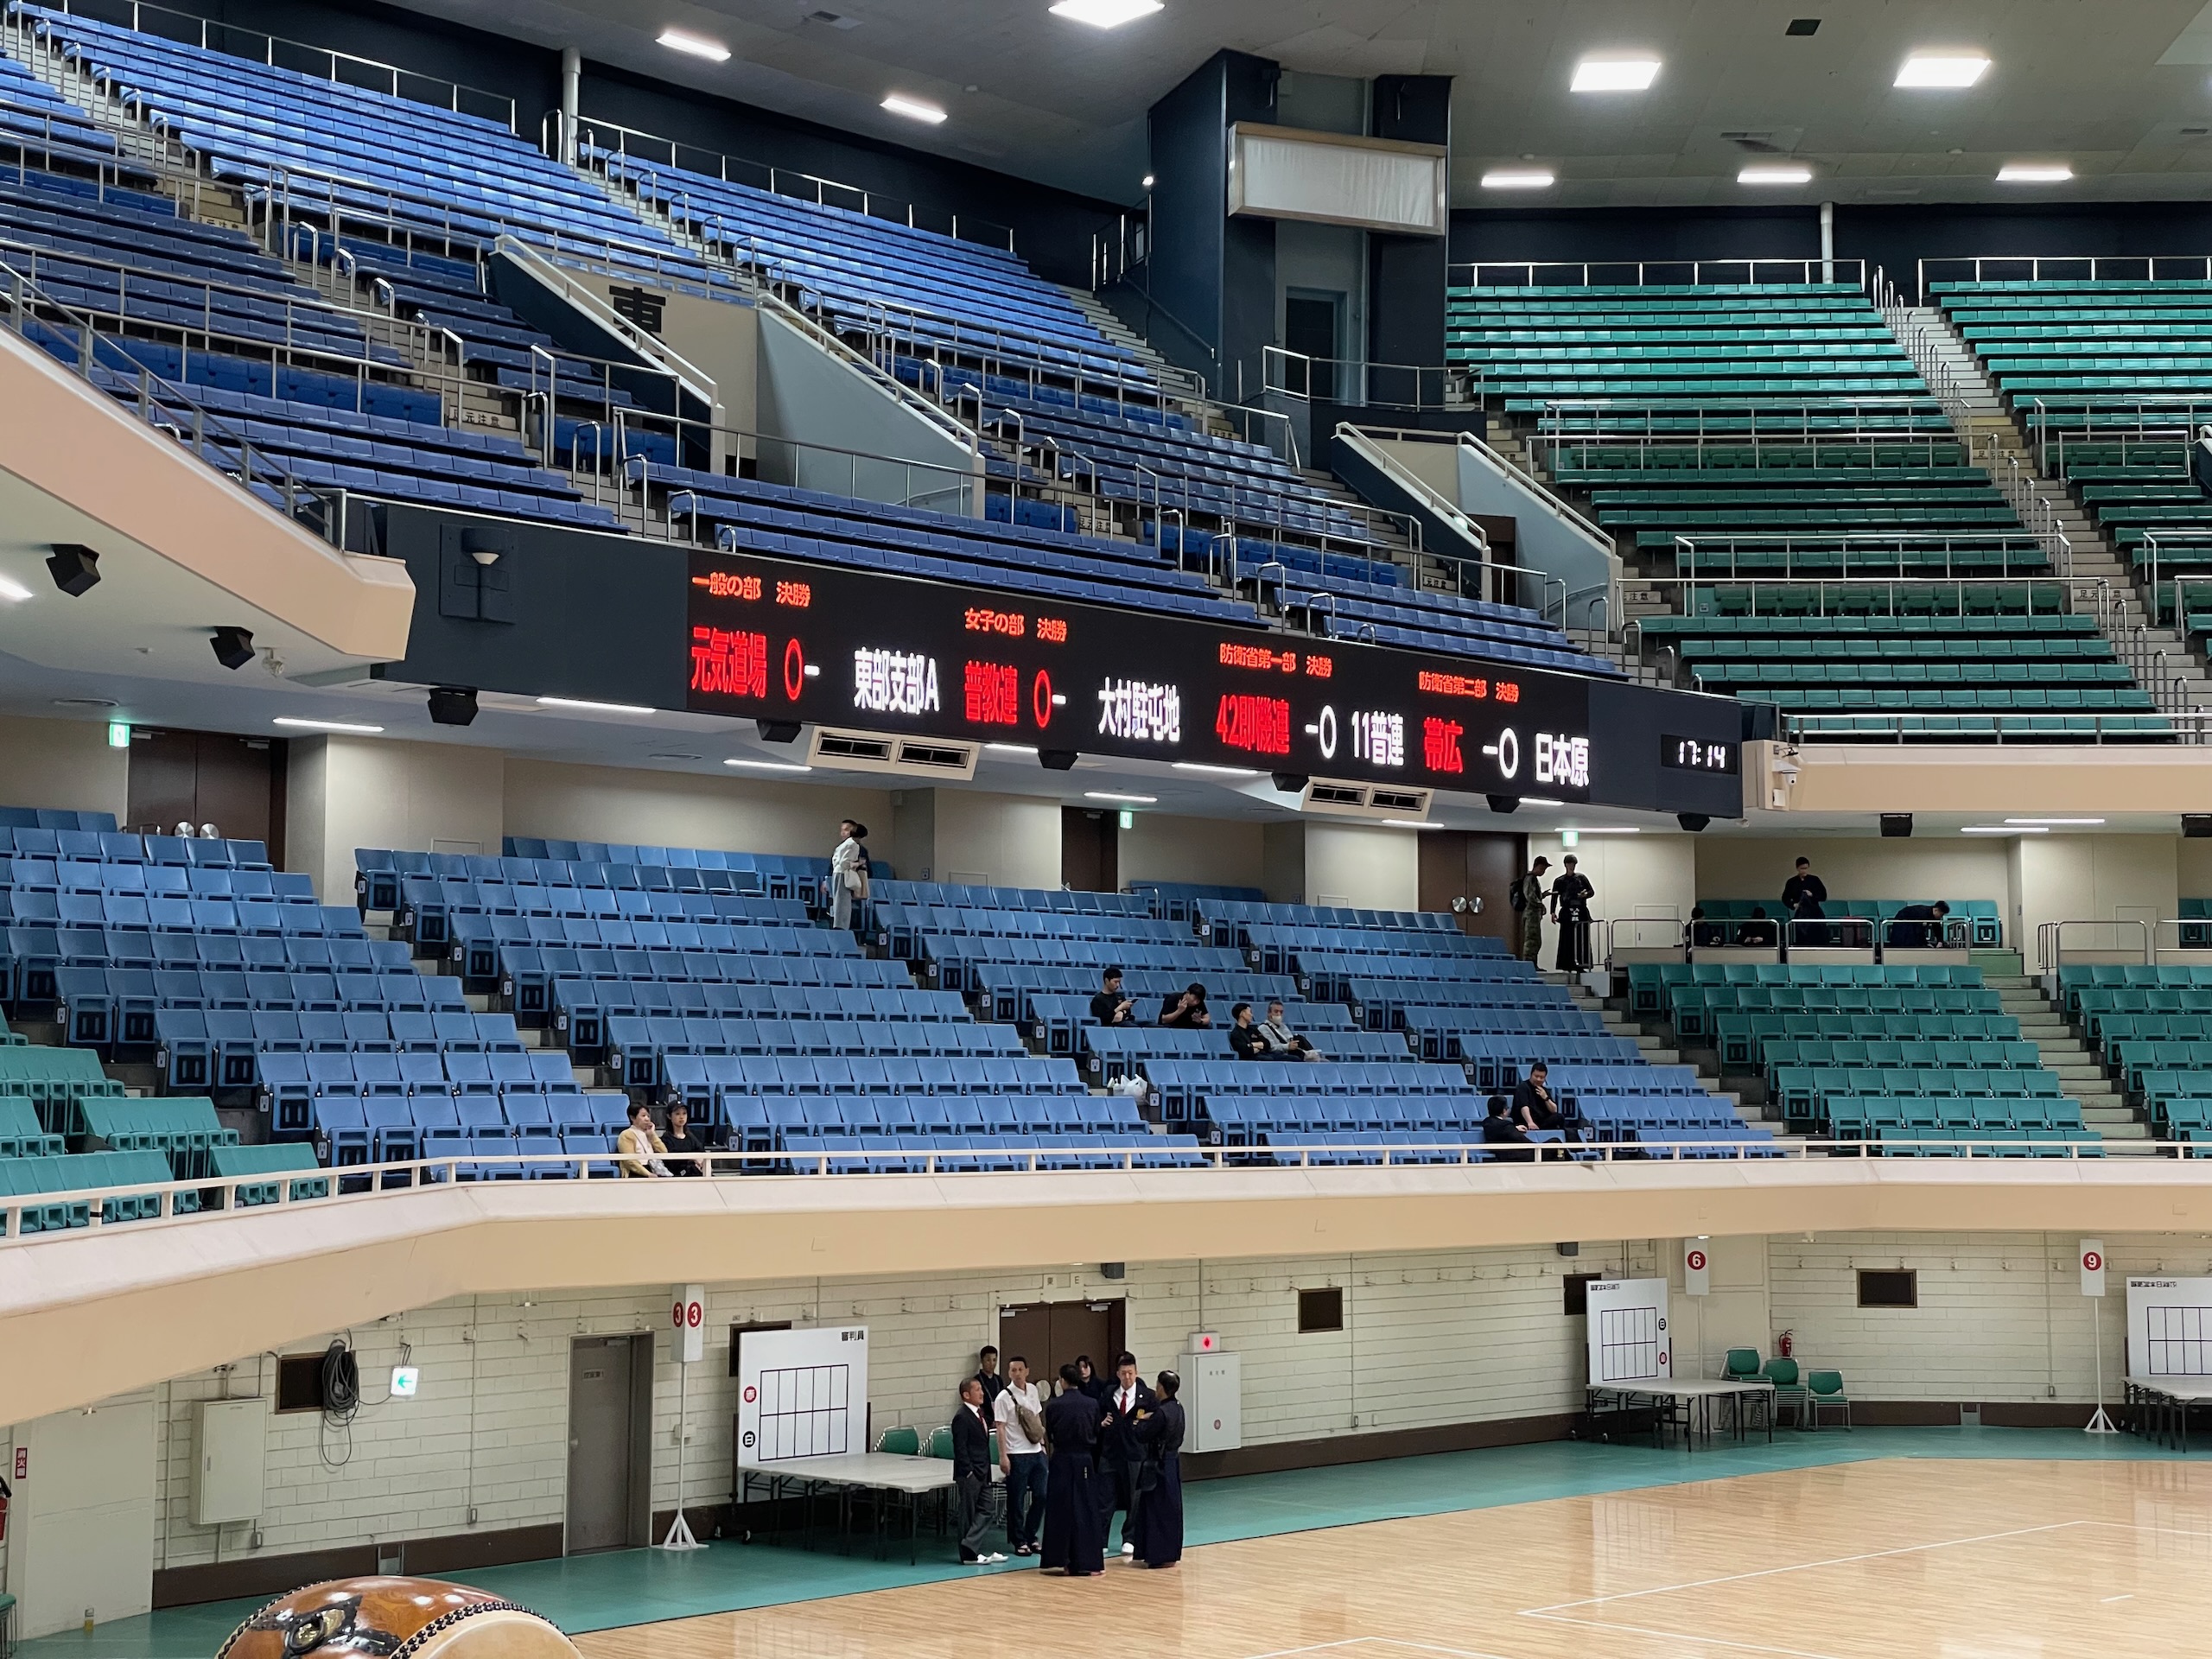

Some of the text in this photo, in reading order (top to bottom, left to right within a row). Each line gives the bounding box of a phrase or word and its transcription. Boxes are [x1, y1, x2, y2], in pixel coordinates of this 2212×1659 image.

[692, 571, 811, 607] 一般の部 決勝
[964, 607, 1067, 642] 女子の部 決勝
[691, 626, 768, 699] 元気道場
[854, 646, 940, 715] 東部支部A
[1219, 643, 1333, 677] 防衛省第一部 決勝
[964, 659, 1018, 726] 普教連
[1098, 676, 1180, 743] 大村駐屯地
[1418, 671, 1520, 702] 防衛省第二部 決勝
[1216, 694, 1291, 755] 42即機連
[1351, 710, 1405, 766] 11普連
[1423, 716, 1464, 774] 帯広
[1535, 733, 1590, 787] 日本原
[1679, 740, 1726, 768] 17:14
[1074, 1275, 1080, 1285] E
